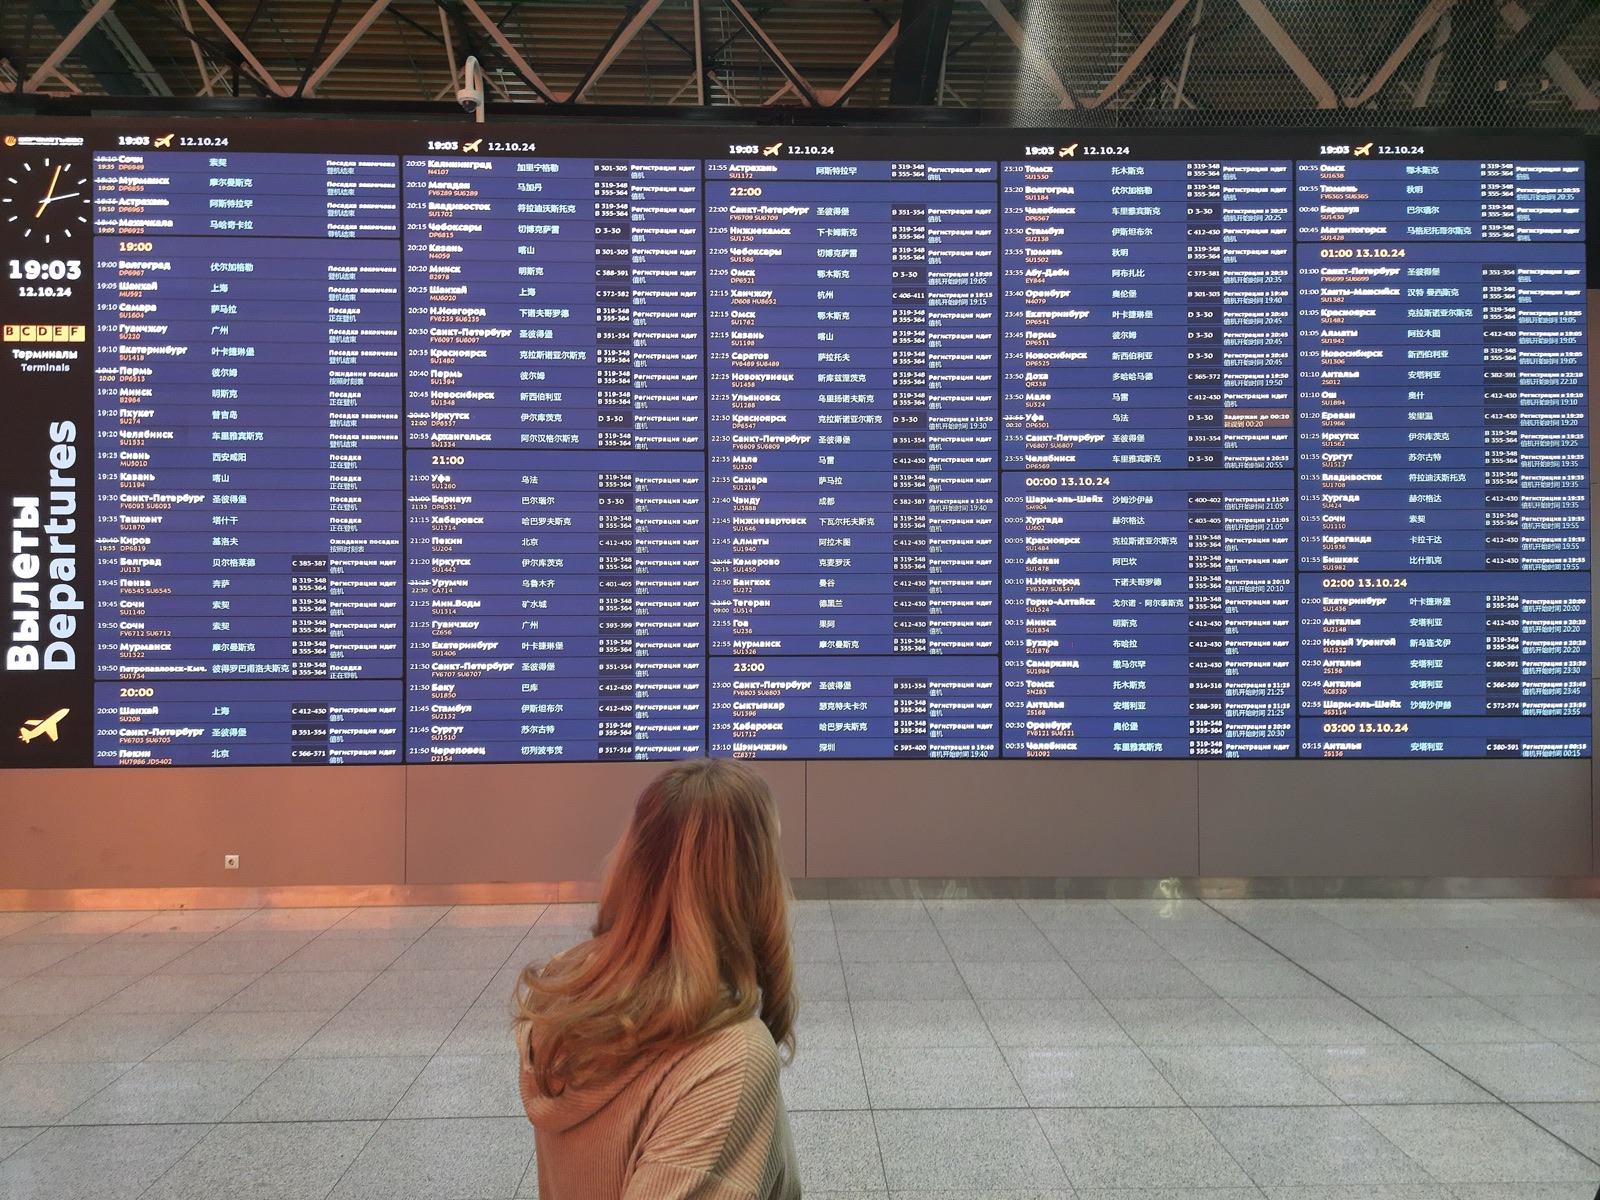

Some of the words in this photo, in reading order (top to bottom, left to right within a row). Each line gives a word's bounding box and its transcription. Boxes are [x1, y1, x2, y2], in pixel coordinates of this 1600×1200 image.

[118, 137, 150, 146] 19:03
[180, 137, 228, 146] 12.10.24
[428, 141, 458, 150] 19:03
[488, 143, 535, 151] 12.10.24
[729, 145, 759, 154] 19:03
[788, 146, 834, 154] 12.10.24
[1025, 146, 1054, 155] 19:03
[1084, 147, 1129, 155] 12.10.24
[1320, 146, 1349, 154] 19:03
[1379, 146, 1424, 154] 12.10.24
[730, 188, 761, 196] 22:00
[119, 242, 152, 251] 19:00
[1112, 248, 1128, 257] 秋明
[1320, 249, 1352, 258] 01:00
[1356, 249, 1405, 258] 13.10.24
[9, 259, 81, 280] 19:03
[1026, 268, 1070, 277] Абу-Даби
[19, 287, 72, 297] 12.10.24
[119, 303, 157, 312] Самара
[6, 327, 13, 336] B
[22, 327, 30, 336] C
[39, 327, 47, 336] D
[55, 327, 62, 336] E
[71, 327, 78, 336] F
[120, 324, 168, 335] Гуанчжоу
[211, 326, 228, 335] 广州
[12, 349, 77, 360] Терминалы
[120, 345, 187, 355] Екатеринбург
[430, 349, 487, 359] Красноярск
[732, 352, 769, 361] Саратов
[431, 370, 462, 380] Пермь
[520, 371, 545, 380] 彼尔姆
[1026, 373, 1048, 381] Доха
[120, 388, 152, 397] Минск
[431, 391, 494, 400] Новосибирск
[431, 412, 470, 421] Иркутск
[732, 414, 786, 424] Красноярск
[1026, 413, 1044, 422] Уфа
[432, 433, 491, 443] Архангельск
[1322, 433, 1359, 441] Иркутск
[120, 452, 150, 460] Сиань
[432, 456, 464, 465] 21:00
[1322, 453, 1353, 462] Сургут
[1408, 453, 1441, 462] 苏尔古特
[432, 475, 451, 484] Уфа
[522, 476, 538, 484] 乌法
[1026, 477, 1057, 486] 00:00
[1061, 477, 1110, 486] 13.10.24
[1322, 473, 1382, 482] Владивосток
[120, 494, 205, 504] Санкт-Петербург
[432, 496, 472, 505] Барнаул
[733, 497, 760, 506] Чэнду
[1026, 495, 1103, 504] Шарм-эль-Шейх
[432, 517, 484, 525] Хабаровск
[733, 518, 806, 526] Нижневартовск
[1026, 516, 1063, 525] Хургада
[44, 420, 84, 671] Departures
[120, 536, 150, 546] Киров
[819, 538, 851, 546] 阿拉木图
[120, 557, 161, 567] Белград
[1113, 558, 1137, 566] 阿巴坎
[6, 496, 40, 671] Вылеты
[819, 579, 835, 588] 曼谷
[1323, 578, 1354, 588] 02:00
[1358, 578, 1407, 588] 13.10.24
[120, 600, 144, 608] Сочи
[733, 599, 770, 608] Тегеран
[1026, 598, 1095, 607] Горно-Алтайск
[1323, 597, 1387, 606] Екатеринбург
[432, 642, 498, 651] Екатеринбург
[1026, 639, 1059, 648] Бухара
[1113, 639, 1137, 648] 布哈拉
[1323, 638, 1354, 646] Новый
[1356, 638, 1396, 647] Уренгой
[734, 663, 764, 672] 23:00
[120, 688, 154, 697] 20:00
[432, 684, 454, 693] Баку
[522, 684, 538, 692] 巴库
[120, 706, 159, 715] Шанхай
[1324, 724, 1355, 733] 03:00
[1359, 724, 1408, 733] 13.10.24
[212, 749, 229, 758] 北京
